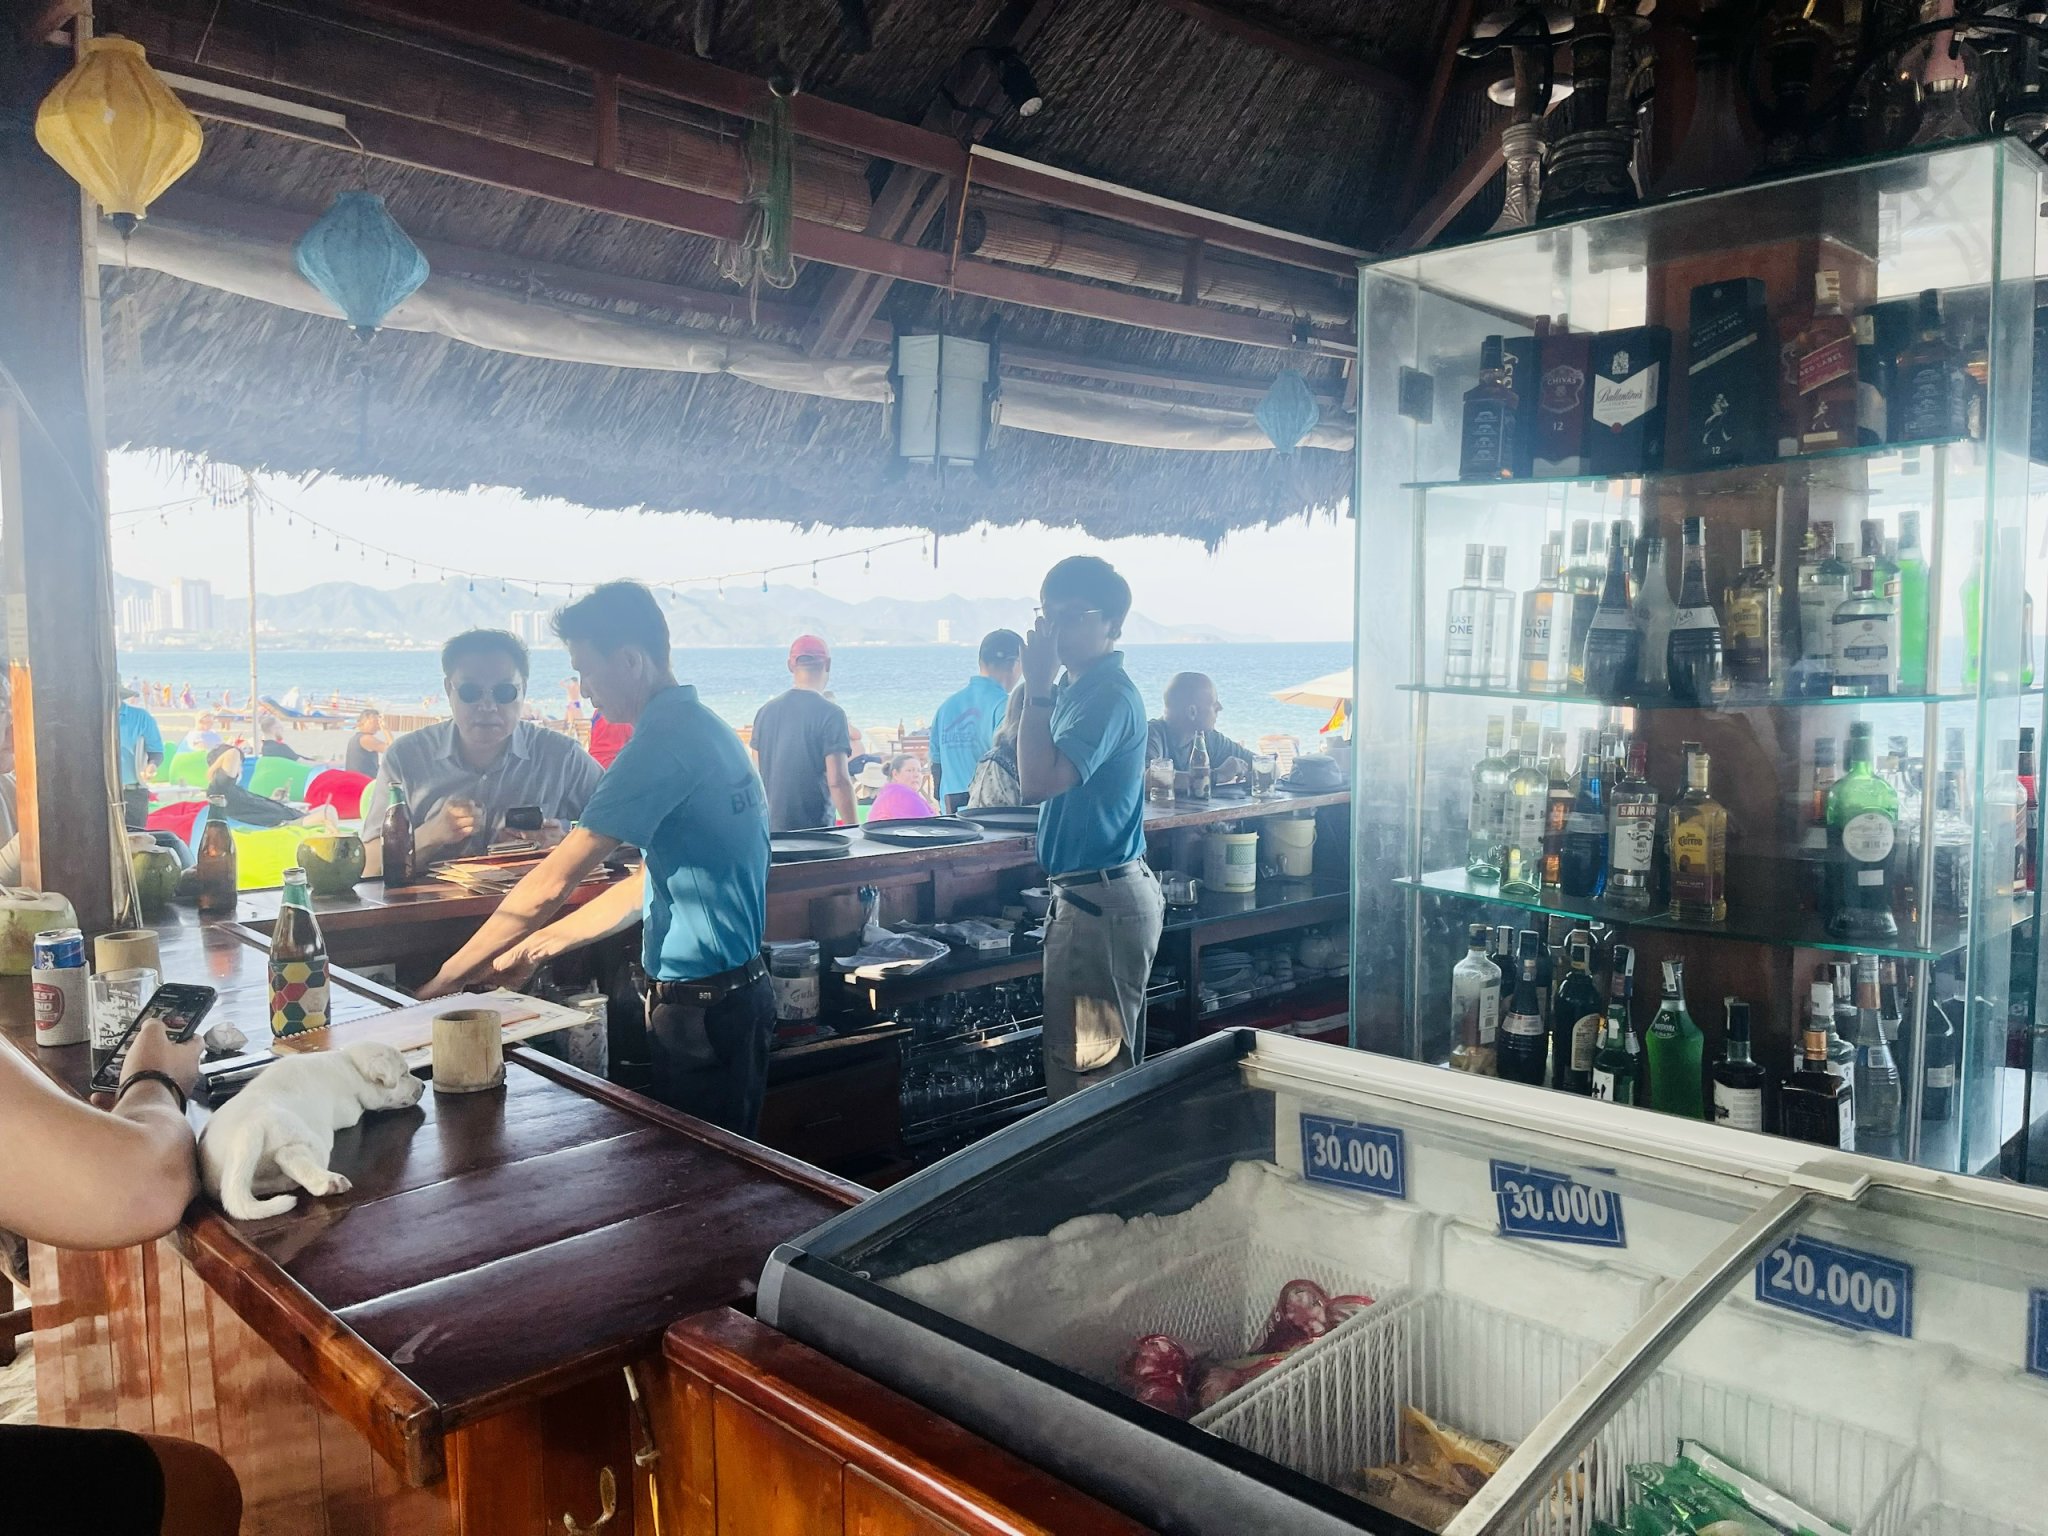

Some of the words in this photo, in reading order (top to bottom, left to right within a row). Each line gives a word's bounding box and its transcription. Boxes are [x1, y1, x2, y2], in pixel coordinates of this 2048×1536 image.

[1547, 377, 1577, 385] CHIVAS
[1598, 387, 1643, 403] Ballantine's
[1552, 421, 1564, 431] 12
[1711, 446, 1721, 455] 12
[1451, 615, 1472, 624] LAST
[1526, 618, 1549, 628] LAST
[1448, 624, 1473, 635] ONE
[1523, 628, 1550, 639] ONE
[1311, 1132, 1394, 1180] 30.000
[1504, 1181, 1609, 1227] 30.000
[1771, 1249, 1896, 1319] 20.000
